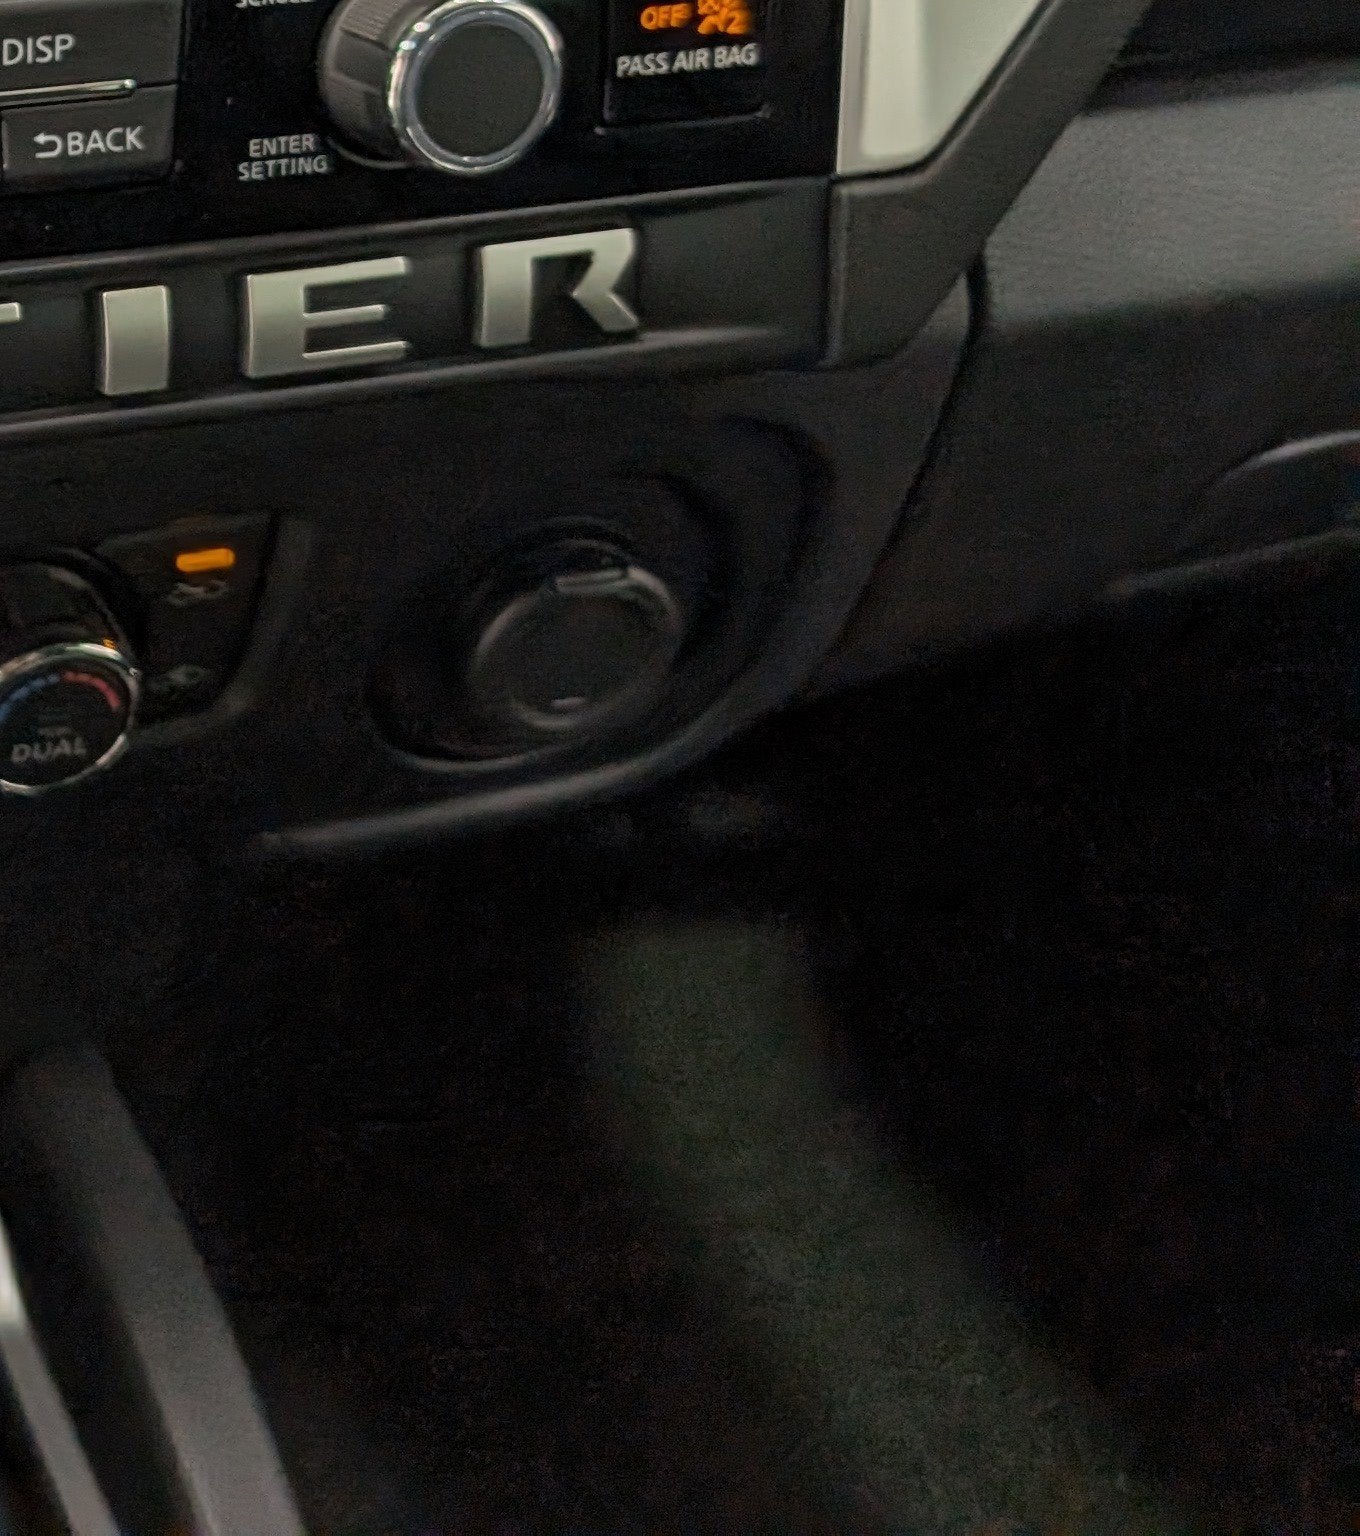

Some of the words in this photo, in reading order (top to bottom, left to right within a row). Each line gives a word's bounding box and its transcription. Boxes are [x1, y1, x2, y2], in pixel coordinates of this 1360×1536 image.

[640, 2, 691, 31] OFF
[2, 33, 76, 67] DISP
[616, 50, 669, 78] PASS
[672, 47, 709, 73] AIR
[713, 42, 760, 70] BAG
[65, 125, 144, 158] BACK
[249, 133, 316, 159] ENTER
[238, 154, 329, 182] SETTING
[11, 737, 89, 764] DUAL
